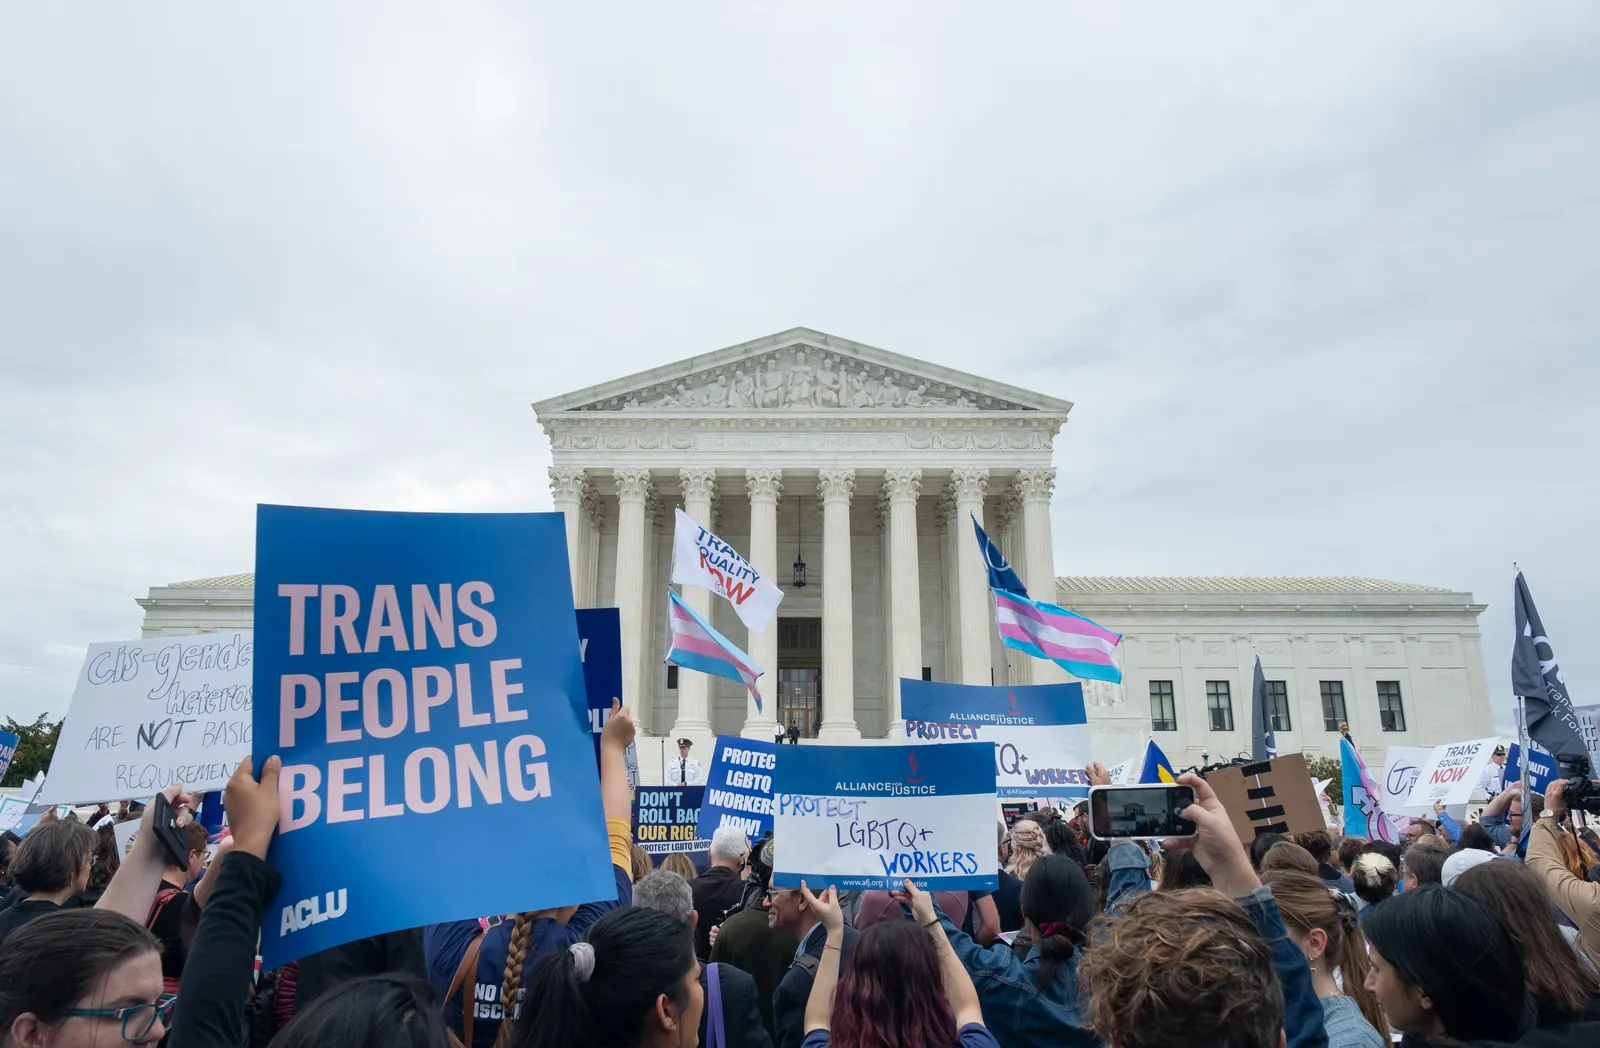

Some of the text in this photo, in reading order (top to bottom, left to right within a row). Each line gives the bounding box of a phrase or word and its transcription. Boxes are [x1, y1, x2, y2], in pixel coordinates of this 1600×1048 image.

[755, 436, 808, 447] JUSTICE
[816, 436, 861, 447] UNDER
[868, 436, 895, 447] LAW
[698, 525, 759, 576] TRA
[695, 541, 761, 584] QUALITY
[278, 580, 498, 656] TRANS
[279, 658, 528, 748] PEOPLE
[950, 712, 995, 722] ALLIANCE
[996, 716, 1035, 726] JUSTICE
[84, 725, 126, 750] ARE
[137, 718, 196, 750] NOT
[906, 719, 981, 740] PROTECT
[721, 747, 776, 770] PROTEC
[1445, 743, 1481, 759] TRANS
[1438, 756, 1475, 768] EQUALITY
[278, 734, 552, 835] BELONG
[726, 769, 772, 794] LGBTQ
[1025, 768, 1091, 786] WORKER
[1429, 766, 1469, 785] NOW
[639, 791, 683, 807] DON'T
[835, 782, 892, 791] ALLIANCE
[890, 785, 936, 797] JUSTICE
[638, 808, 672, 824] ROLL
[779, 793, 867, 821] PROTECT
[637, 824, 668, 841] OUR
[836, 818, 933, 850] LGBTQ+
[671, 842, 693, 851] LGBTQ
[879, 851, 978, 877] WORKERS
[842, 880, 883, 890] www.afj.org
[280, 888, 348, 937] ACLU
[474, 982, 497, 1002] NO
